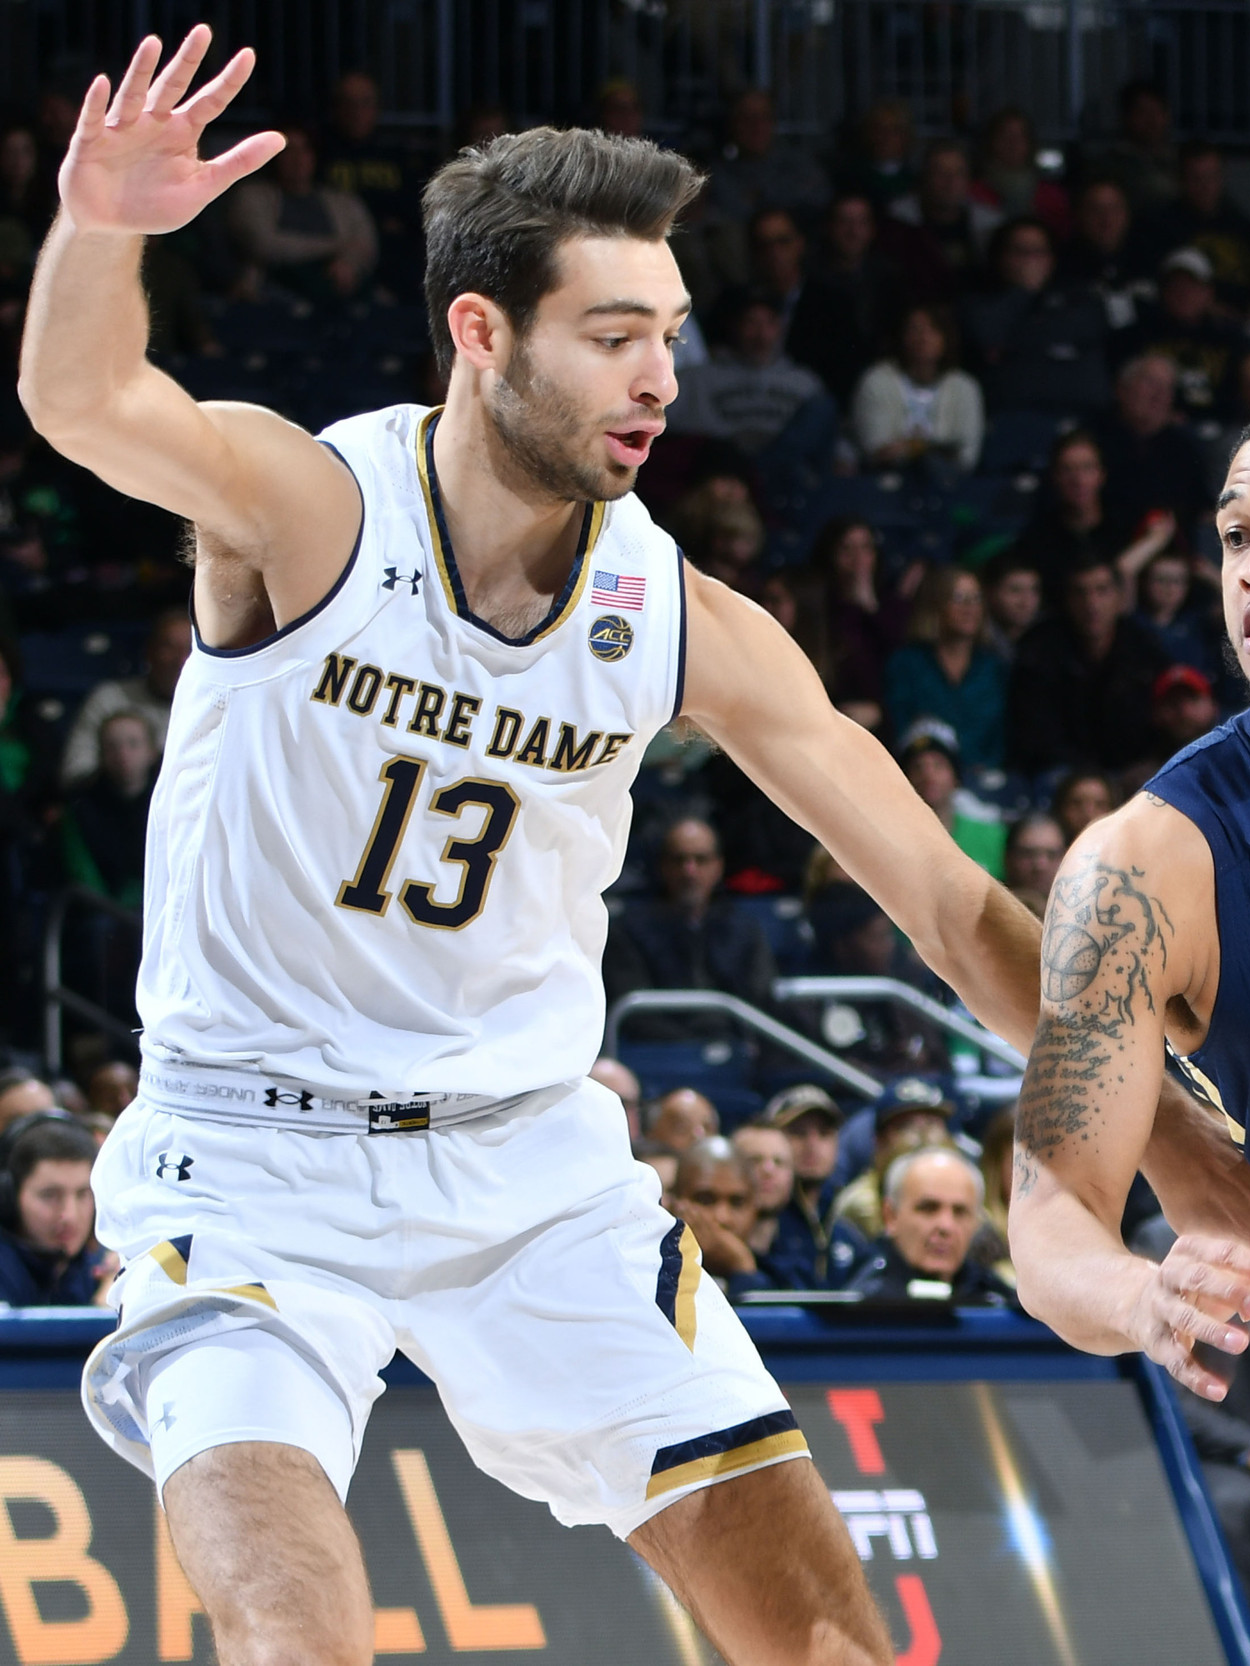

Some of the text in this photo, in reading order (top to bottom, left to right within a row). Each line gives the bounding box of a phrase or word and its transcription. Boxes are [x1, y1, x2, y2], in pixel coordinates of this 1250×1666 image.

[594, 628, 632, 643] ACC
[309, 651, 636, 773] NOTRE DAME
[334, 754, 522, 932] 13
[0, 1449, 547, 1664] BL
